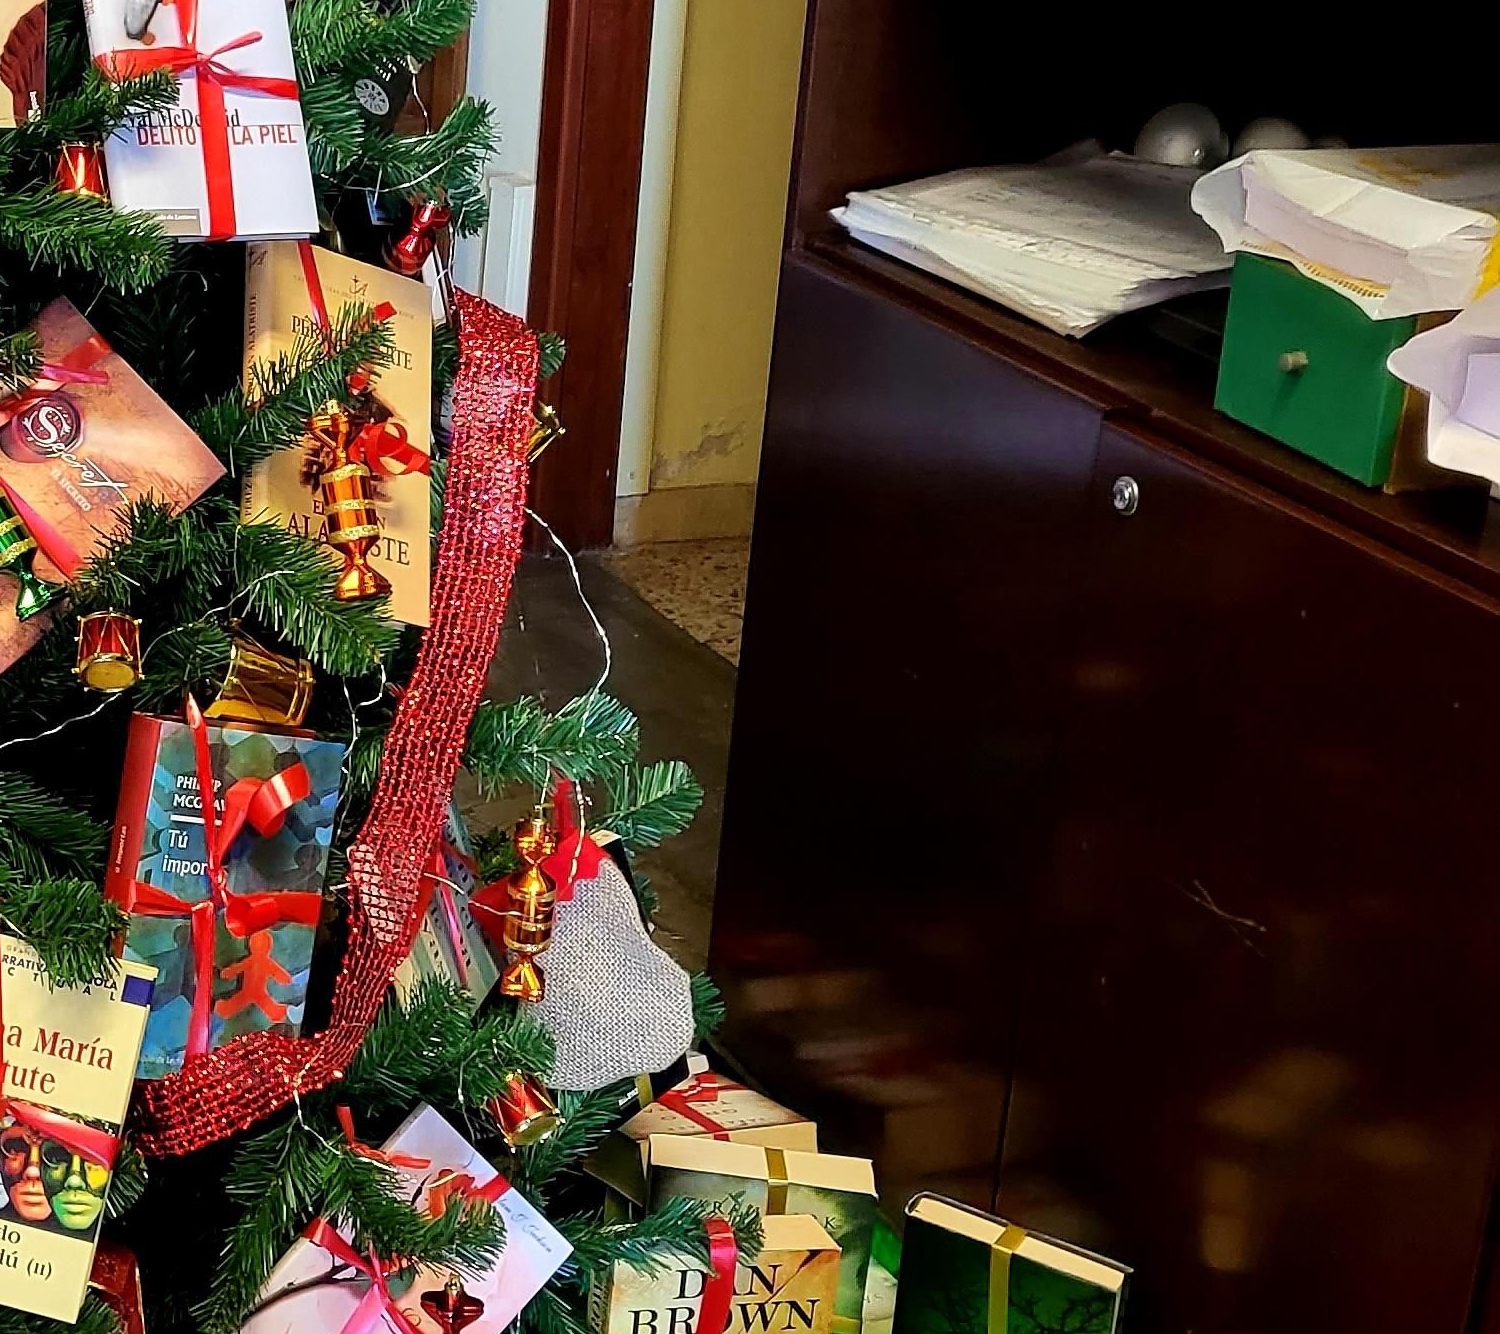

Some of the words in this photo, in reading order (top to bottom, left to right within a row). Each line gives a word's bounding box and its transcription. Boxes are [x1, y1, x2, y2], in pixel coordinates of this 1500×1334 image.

[136, 127, 196, 146] DELITO
[232, 126, 254, 145] LA
[259, 125, 297, 145] PIEL
[167, 827, 189, 850] Tú
[33, 1027, 114, 1070] María
